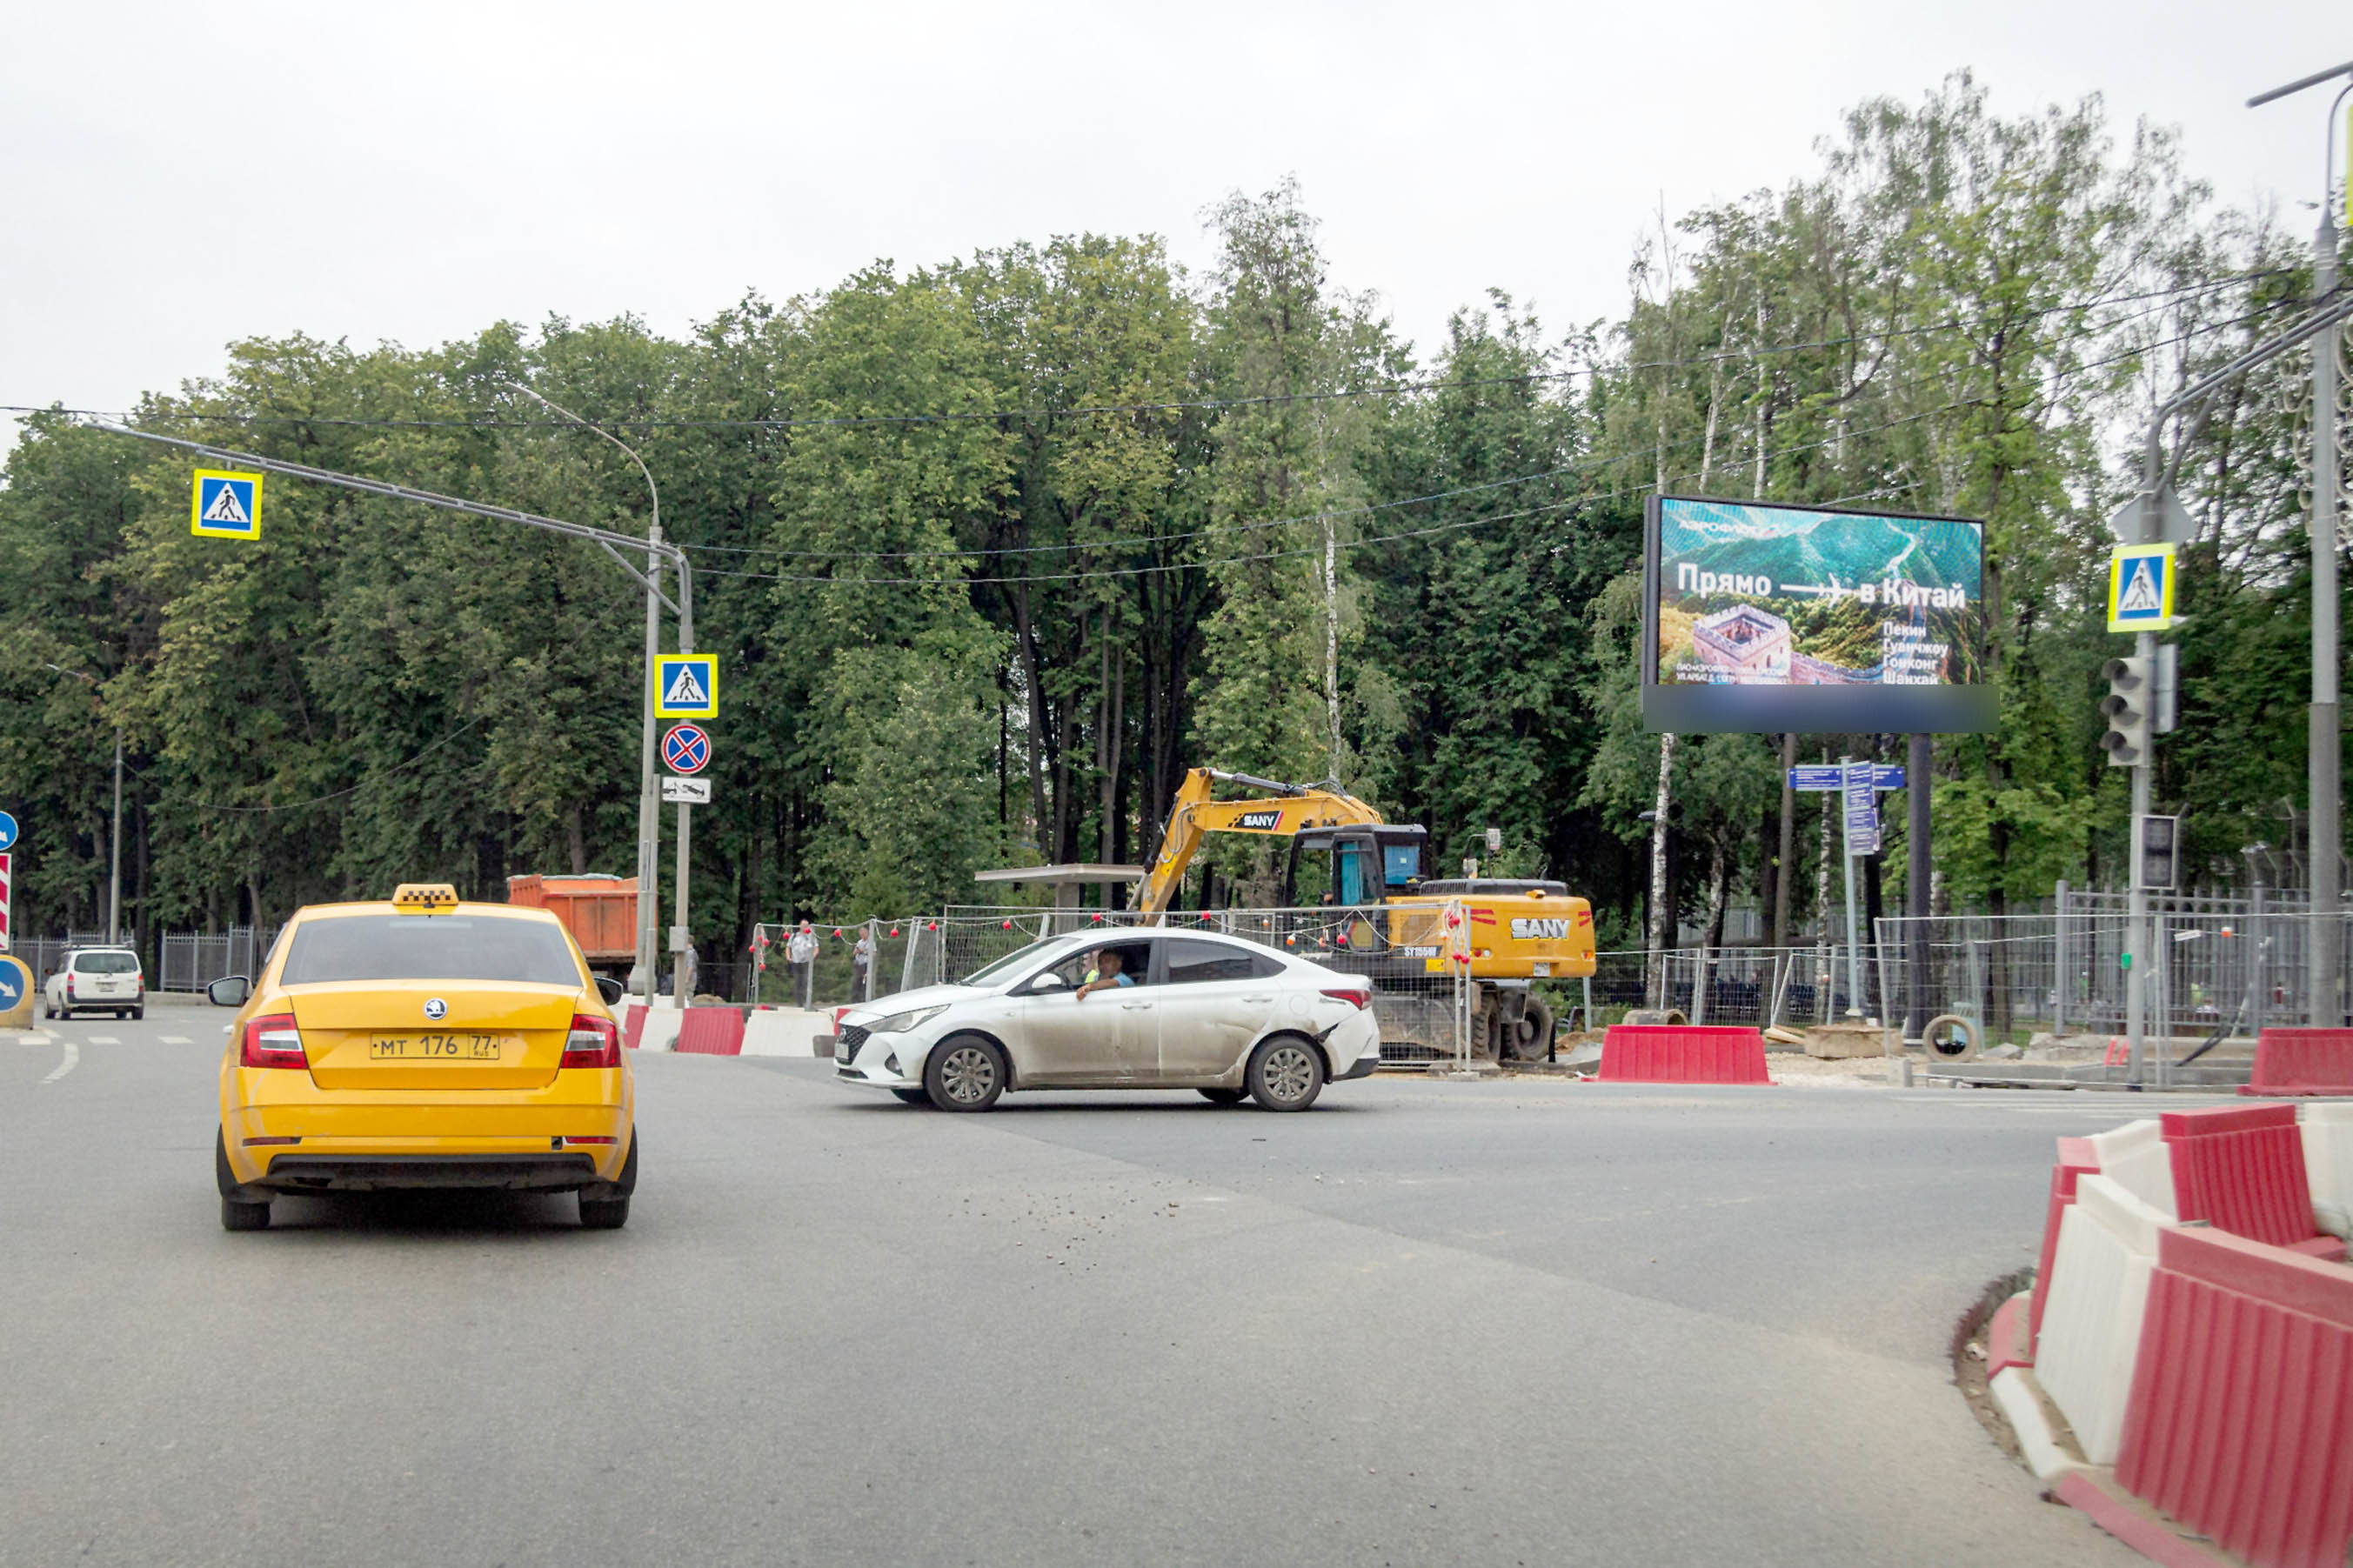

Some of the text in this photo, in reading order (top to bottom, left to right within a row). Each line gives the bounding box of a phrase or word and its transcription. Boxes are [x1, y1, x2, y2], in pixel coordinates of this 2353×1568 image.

[1678, 562, 1966, 609] Прямо в Китай
[1883, 621, 1927, 637] Пекин
[1883, 638, 1949, 658] Гуанчжоу
[1883, 654, 1938, 671] Гонконг
[1882, 670, 1939, 685] Шанхай
[1244, 815, 1274, 827] SANY
[1510, 918, 1570, 939] SANY
[419, 1036, 458, 1055] 176
[471, 1036, 491, 1051] 77
